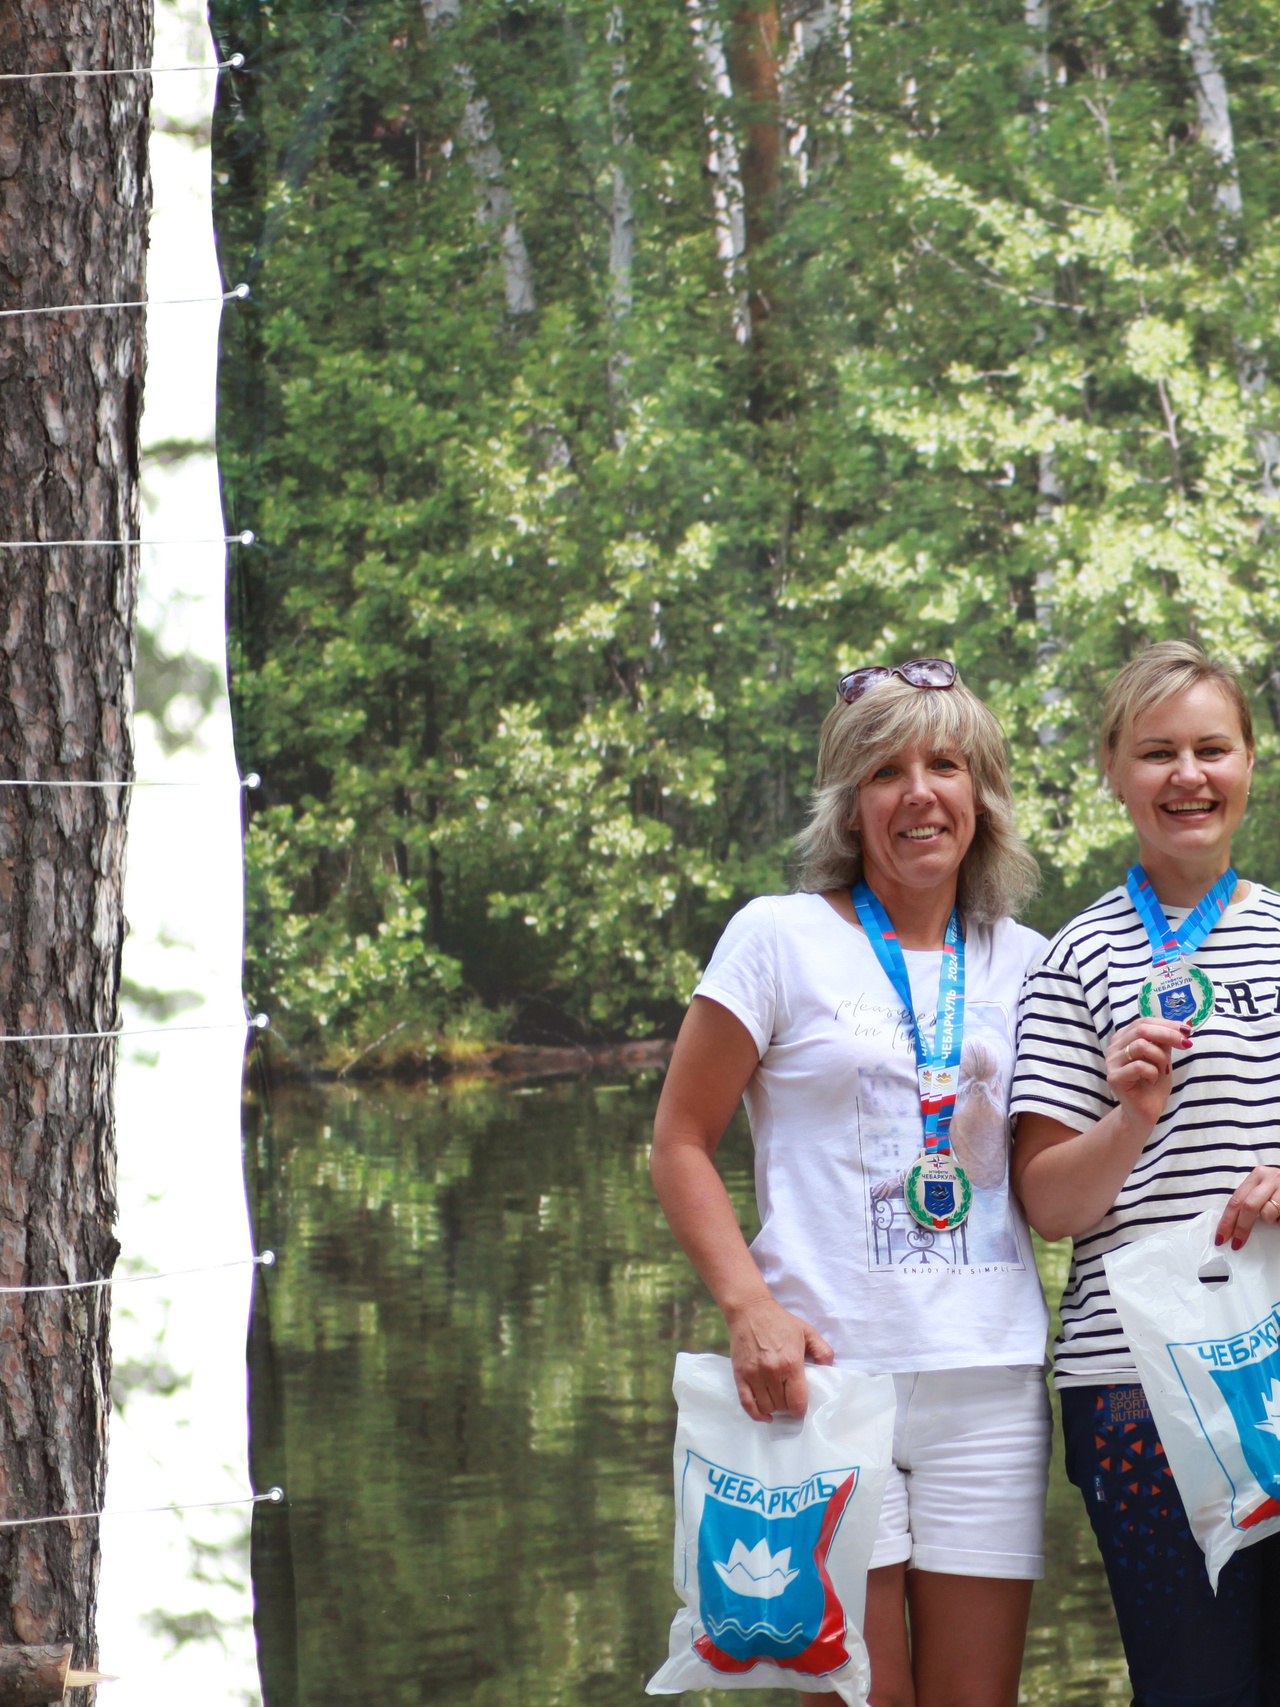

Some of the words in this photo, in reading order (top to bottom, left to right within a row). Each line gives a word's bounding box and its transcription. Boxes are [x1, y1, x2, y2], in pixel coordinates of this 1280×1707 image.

[948, 954, 959, 982] 2024
[941, 989, 957, 1060] ЧЕБАРКУЛЬ
[947, 1267, 962, 1275] THE
